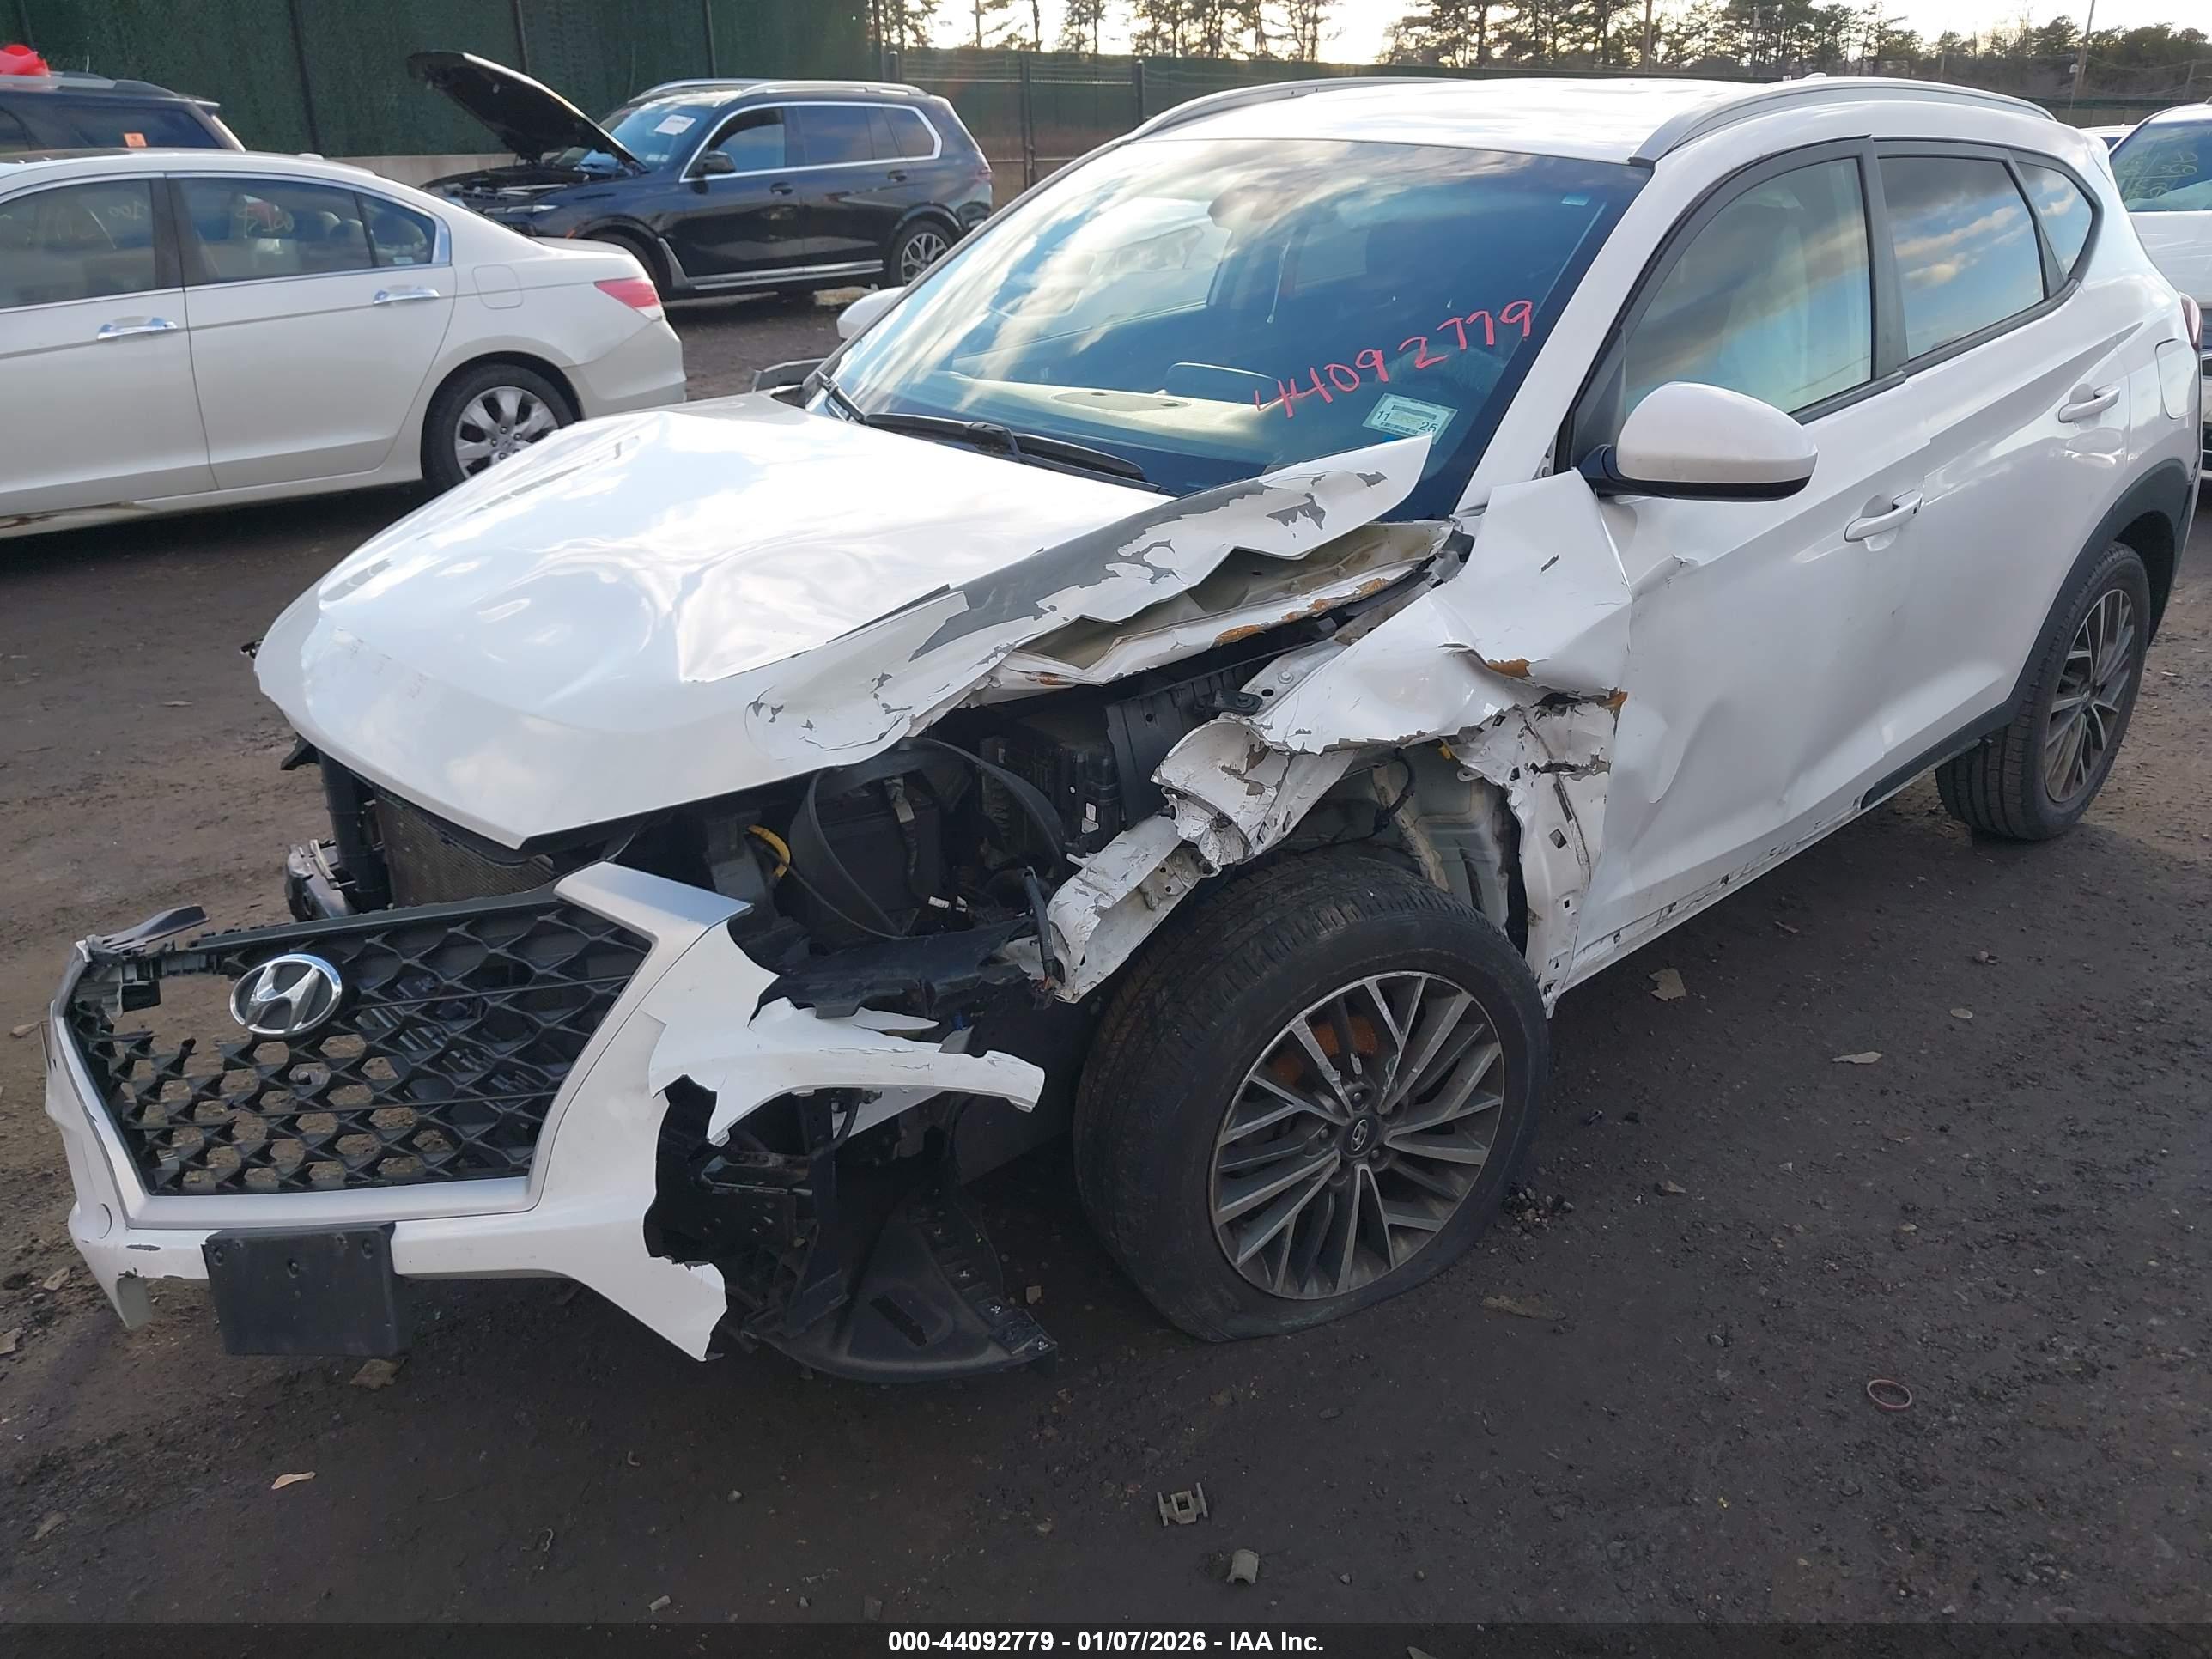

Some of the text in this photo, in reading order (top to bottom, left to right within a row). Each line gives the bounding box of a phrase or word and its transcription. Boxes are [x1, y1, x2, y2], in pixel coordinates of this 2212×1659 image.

[1255, 300, 1534, 418] 44092779
[1376, 410, 1392, 422] 11
[1419, 421, 1439, 433] 25
